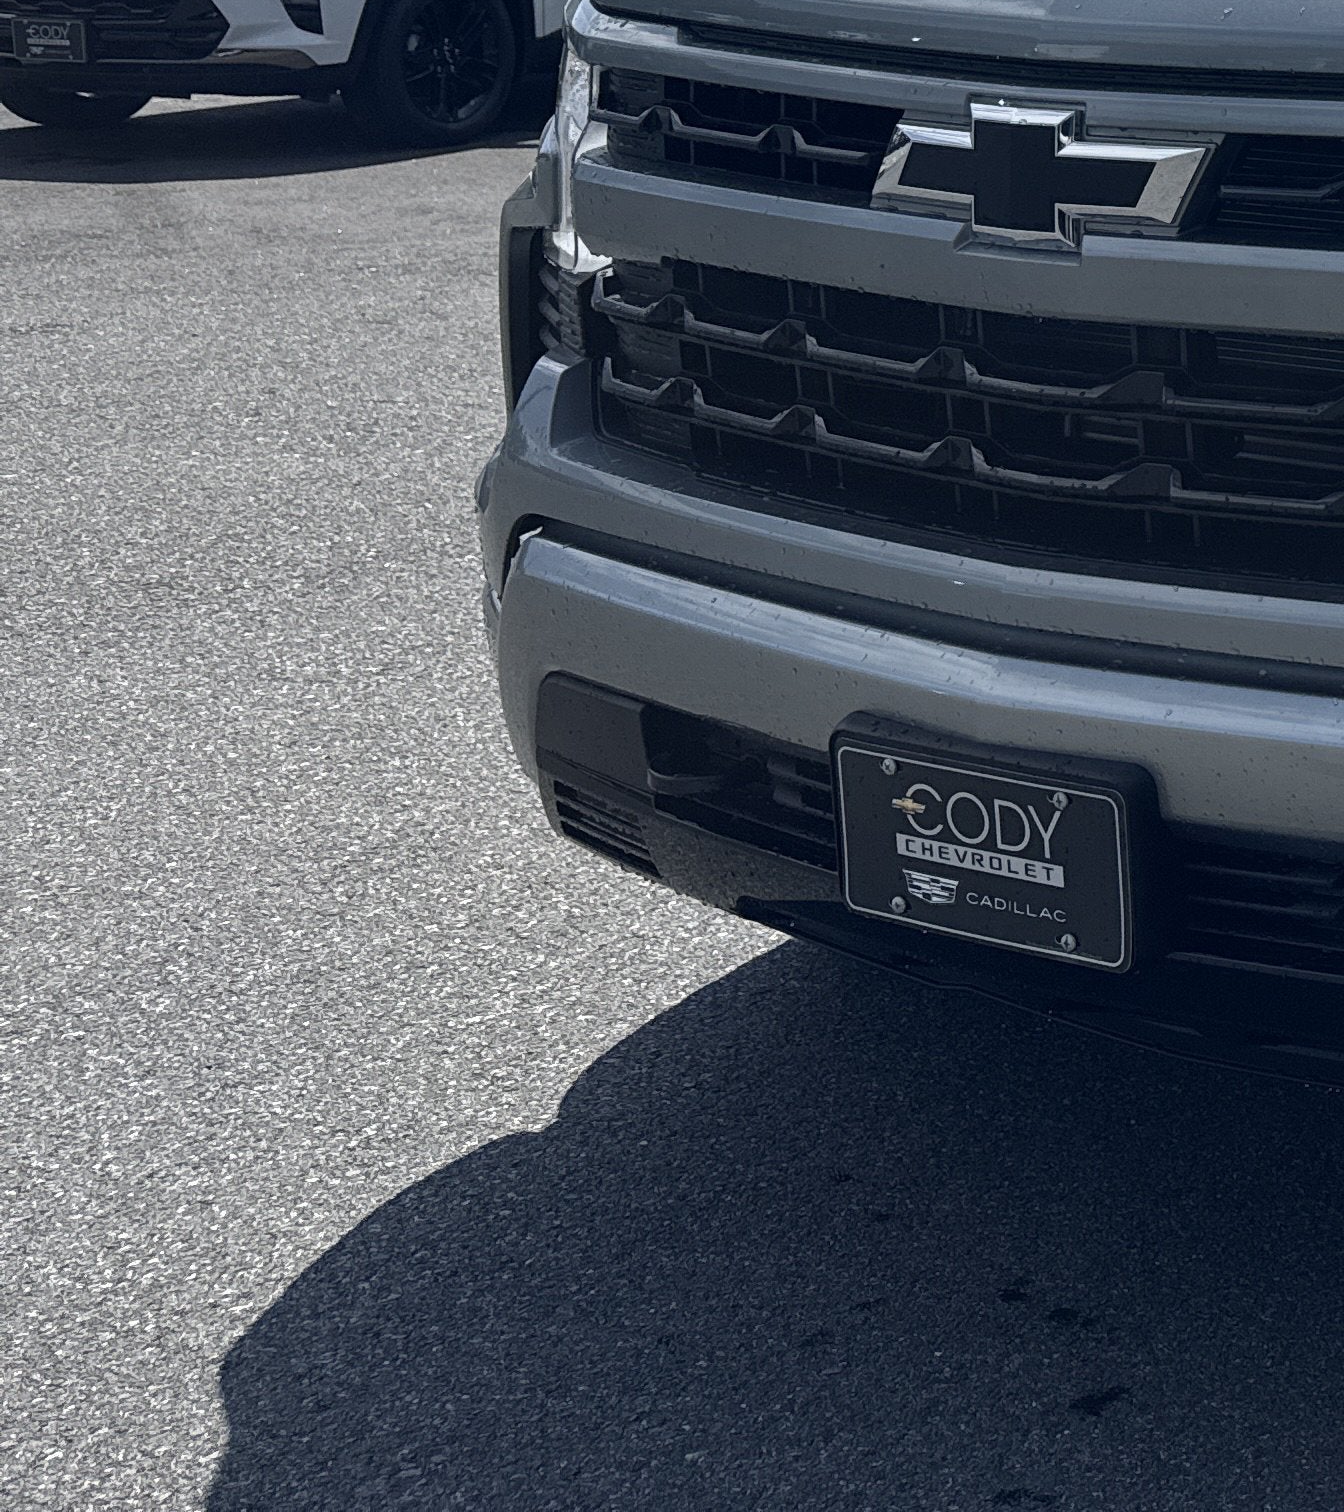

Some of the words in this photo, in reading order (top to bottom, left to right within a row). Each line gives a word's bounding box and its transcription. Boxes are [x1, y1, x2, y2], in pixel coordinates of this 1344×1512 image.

[29, 24, 70, 40] CODY
[905, 783, 1062, 859] CODY
[905, 838, 1056, 882] CHEVROLET
[965, 891, 1068, 924] CADILLAC
